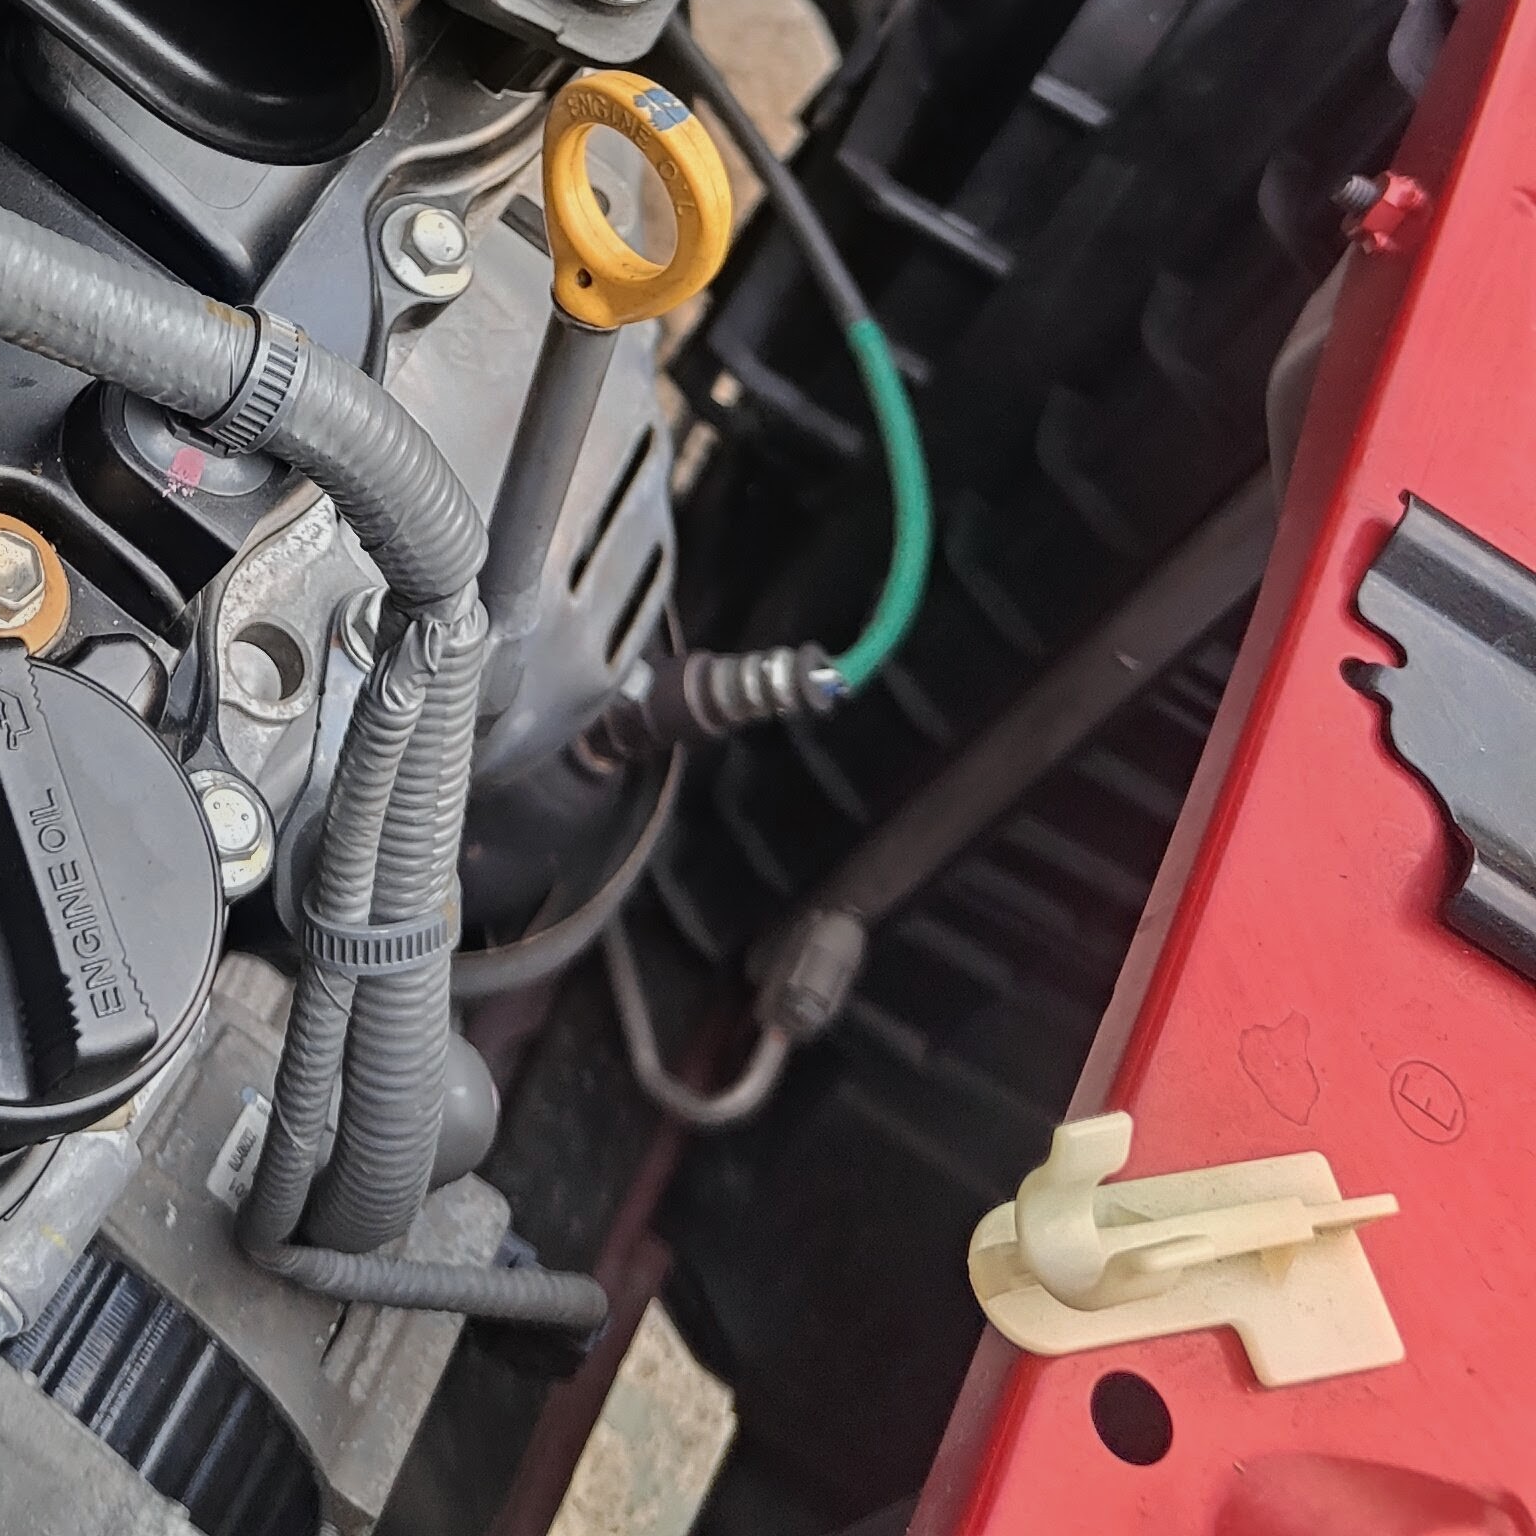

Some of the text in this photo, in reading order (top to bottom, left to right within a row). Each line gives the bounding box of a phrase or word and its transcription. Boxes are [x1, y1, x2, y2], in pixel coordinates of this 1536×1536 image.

[567, 92, 696, 216] ENGINE OIL
[28, 787, 127, 1019] ENGINE OIL
